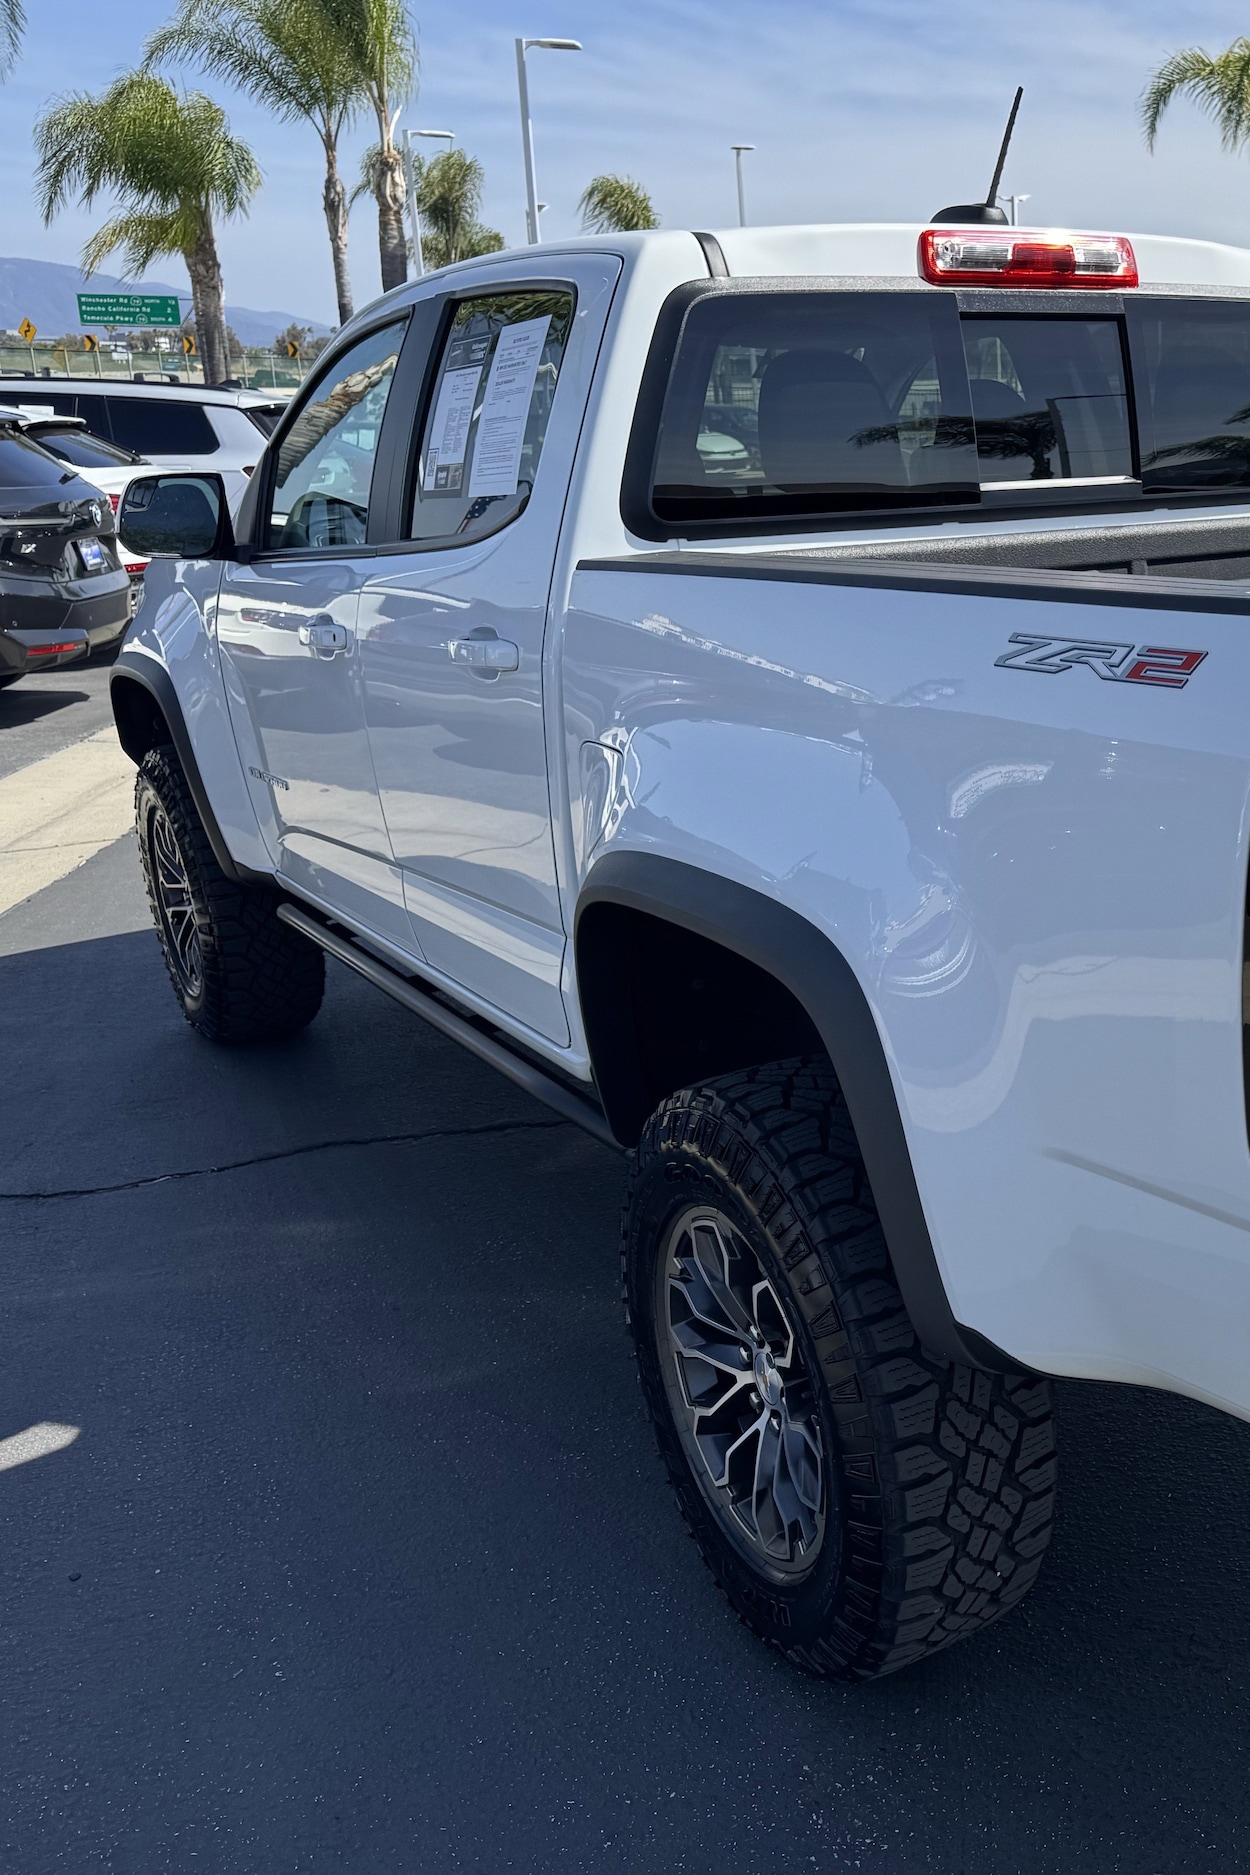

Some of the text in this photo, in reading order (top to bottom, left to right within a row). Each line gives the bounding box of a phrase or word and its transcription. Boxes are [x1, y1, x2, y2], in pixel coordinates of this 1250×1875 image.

[81, 296, 117, 304] Winchester
[107, 305, 140, 313] California
[994, 632, 1209, 689] ZR2
